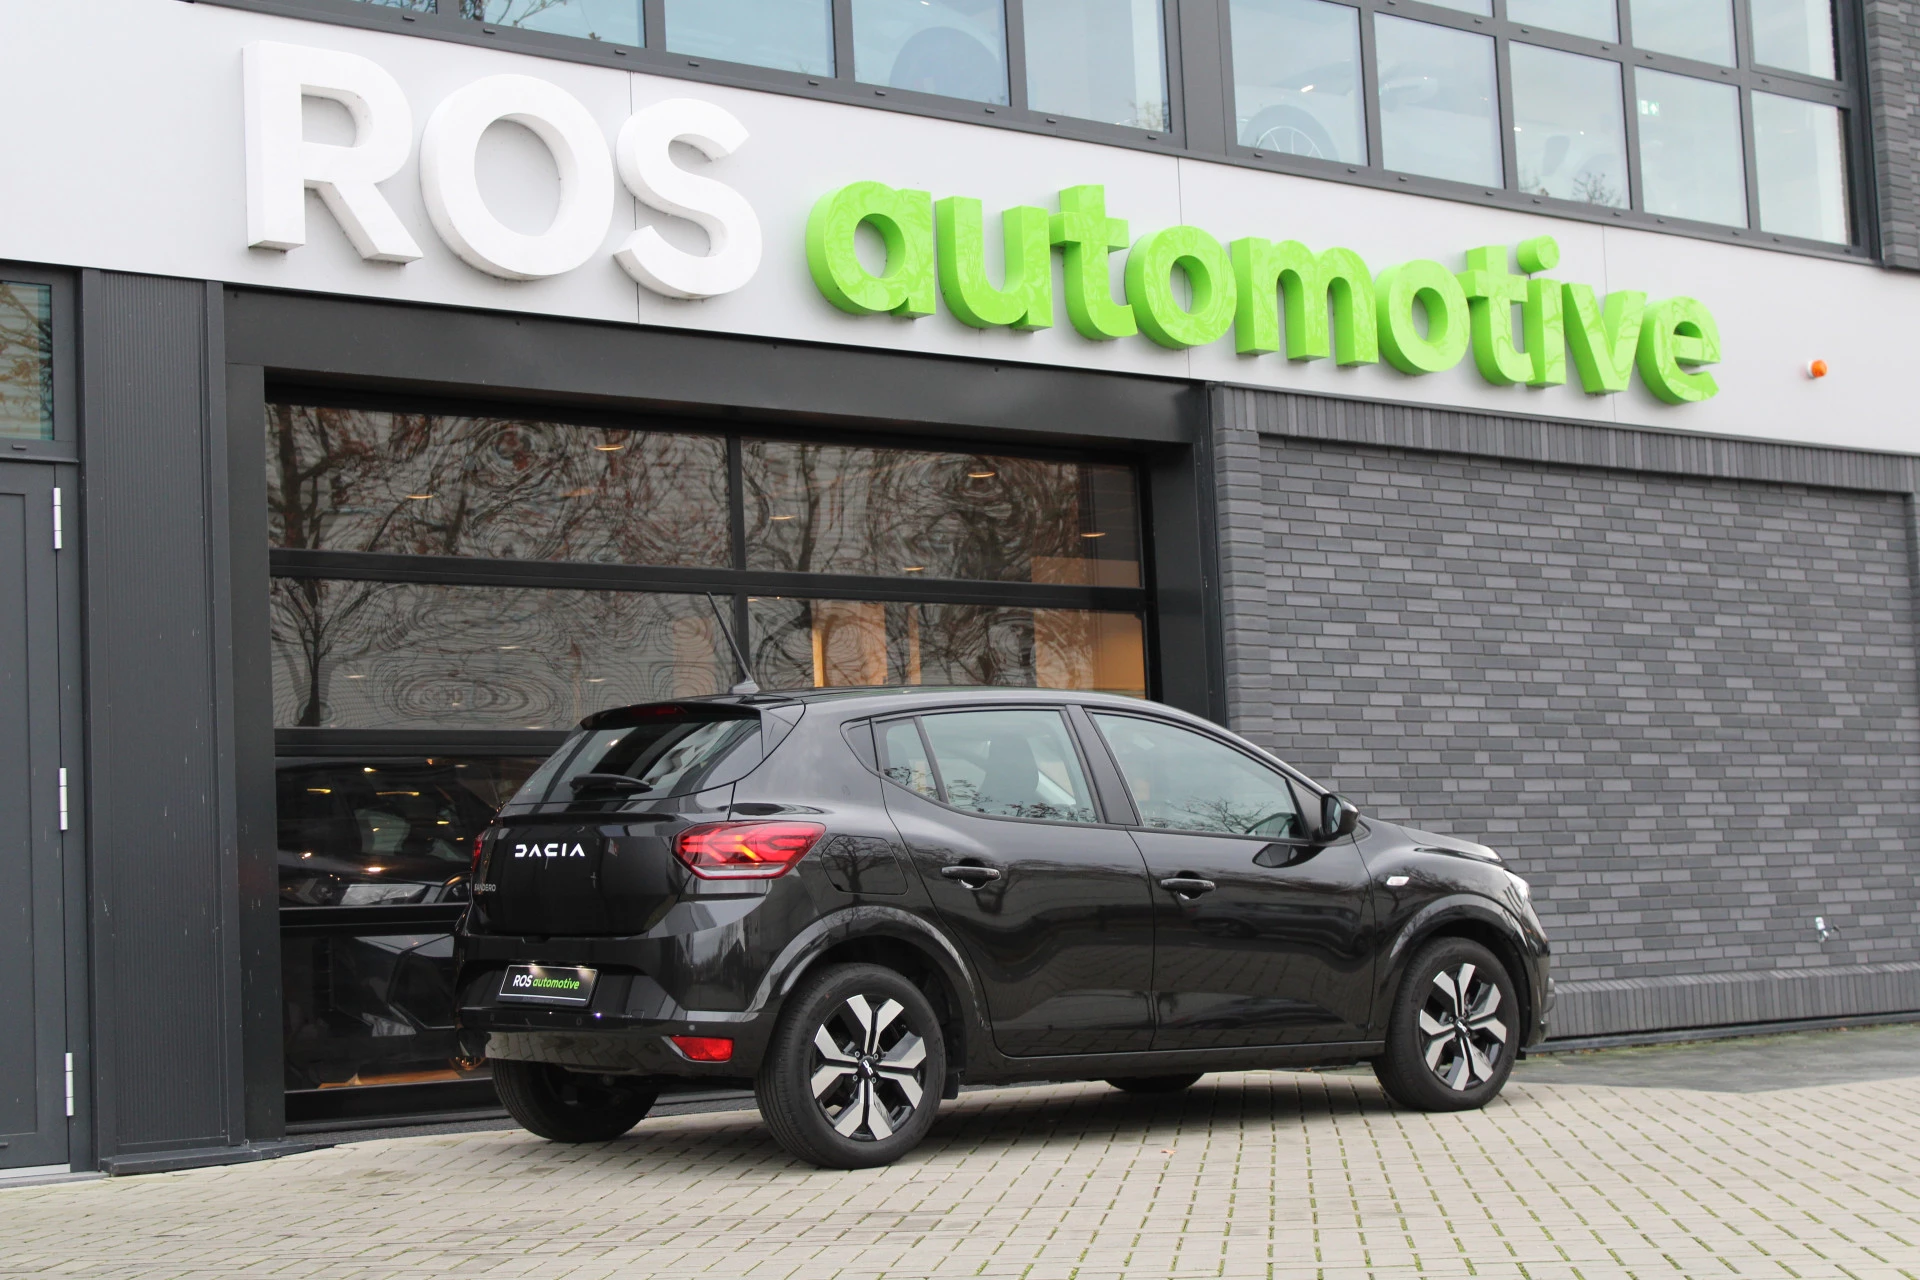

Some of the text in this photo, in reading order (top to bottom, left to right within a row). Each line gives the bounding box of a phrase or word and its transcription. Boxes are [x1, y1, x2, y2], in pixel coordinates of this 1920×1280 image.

[242, 39, 1721, 406] ROS automotive
[514, 843, 586, 858] DACIA
[512, 974, 581, 990] ROS automotive
